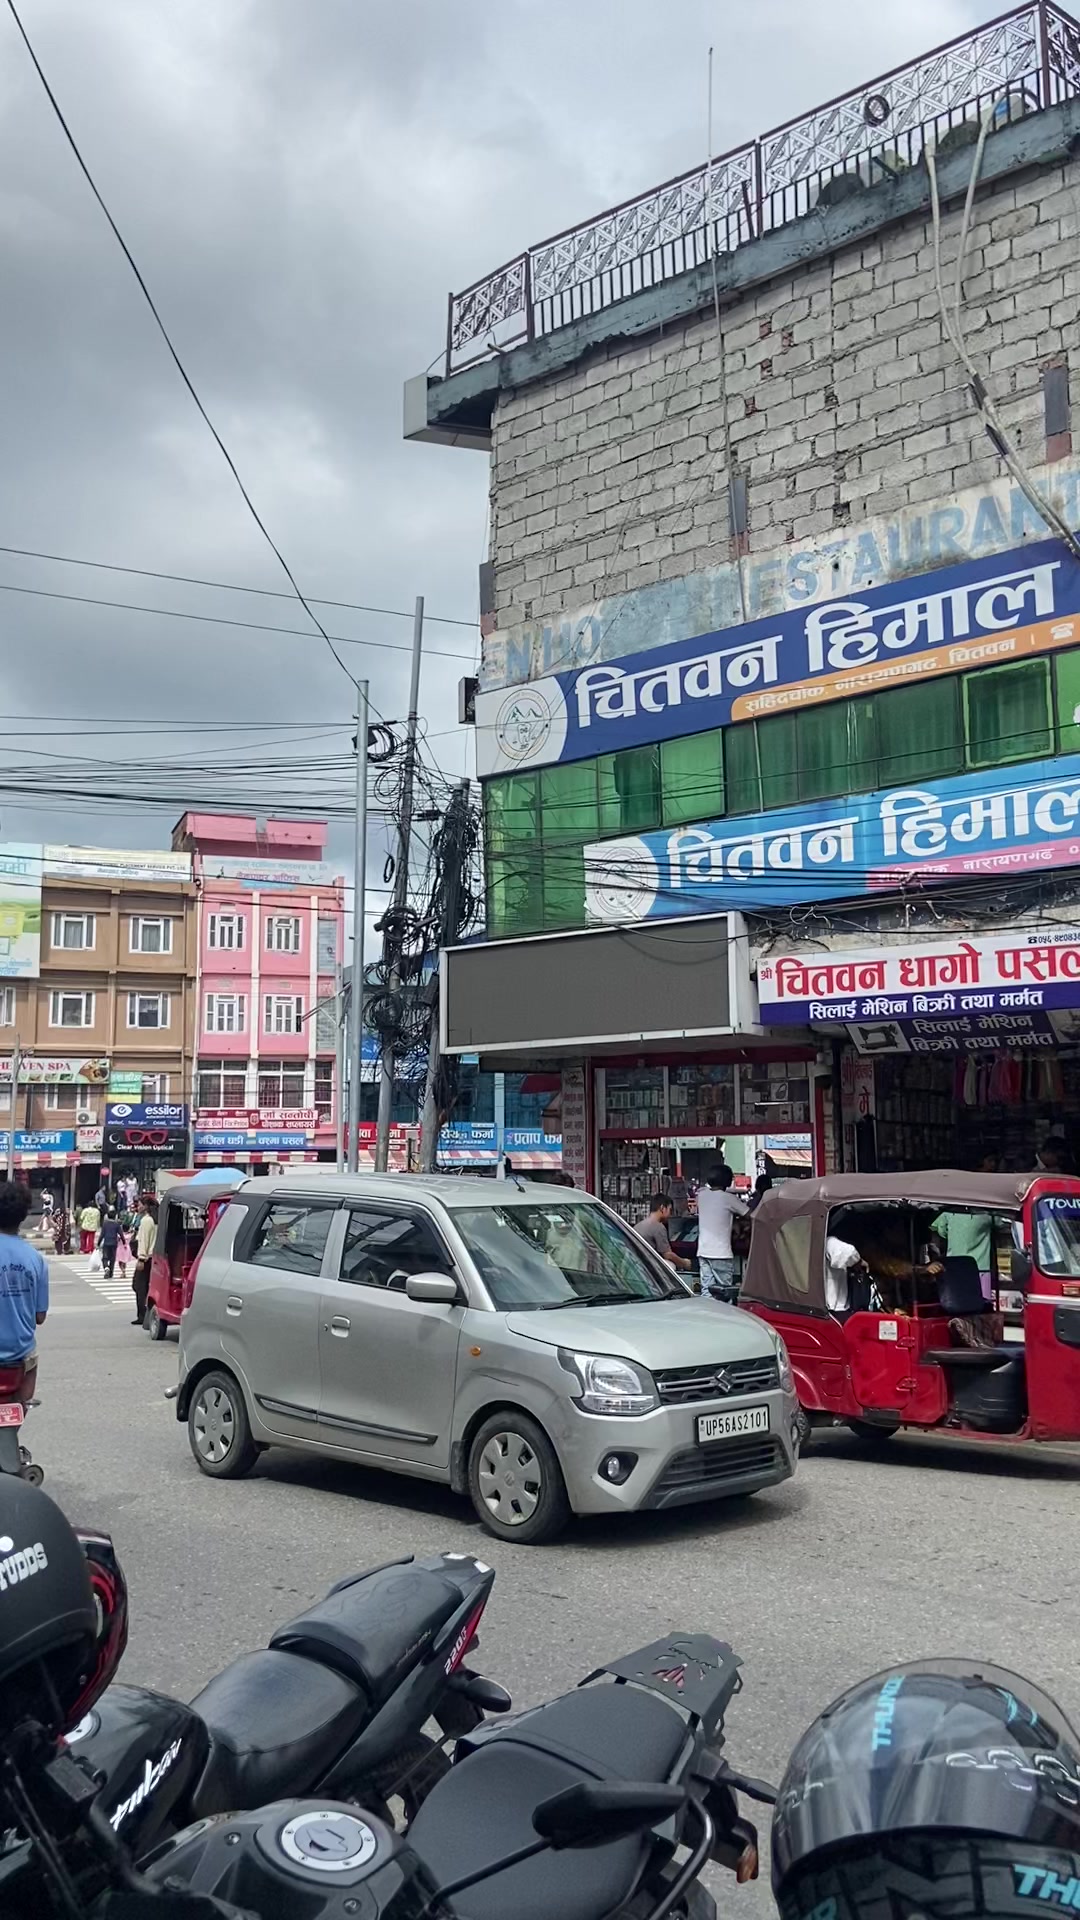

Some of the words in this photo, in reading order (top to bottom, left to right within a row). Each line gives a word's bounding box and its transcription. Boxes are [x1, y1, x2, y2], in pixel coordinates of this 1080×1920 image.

[575, 633, 784, 728] चितवन
[804, 561, 1062, 675] हिमाल
[666, 815, 860, 889] चितवन
[775, 957, 887, 998] चितवन
[899, 942, 982, 987] धागो
[809, 1001, 857, 1020] सिलाई
[861, 994, 907, 1016] मेशिन
[912, 993, 955, 1014] बिक्री
[960, 992, 993, 1011] तथा
[999, 987, 1044, 1008] मर्मत
[912, 1017, 971, 1035] सिलाई
[976, 1012, 1034, 1030] मेशिन
[964, 1036, 1000, 1050] तथा
[1004, 1031, 1055, 1048] मर्मत
[0, 1061, 44, 1071] HEVEN
[48, 1062, 71, 1071] SPA
[145, 1105, 182, 1115] essilor
[706, 1411, 767, 1436] UP56AS2101
